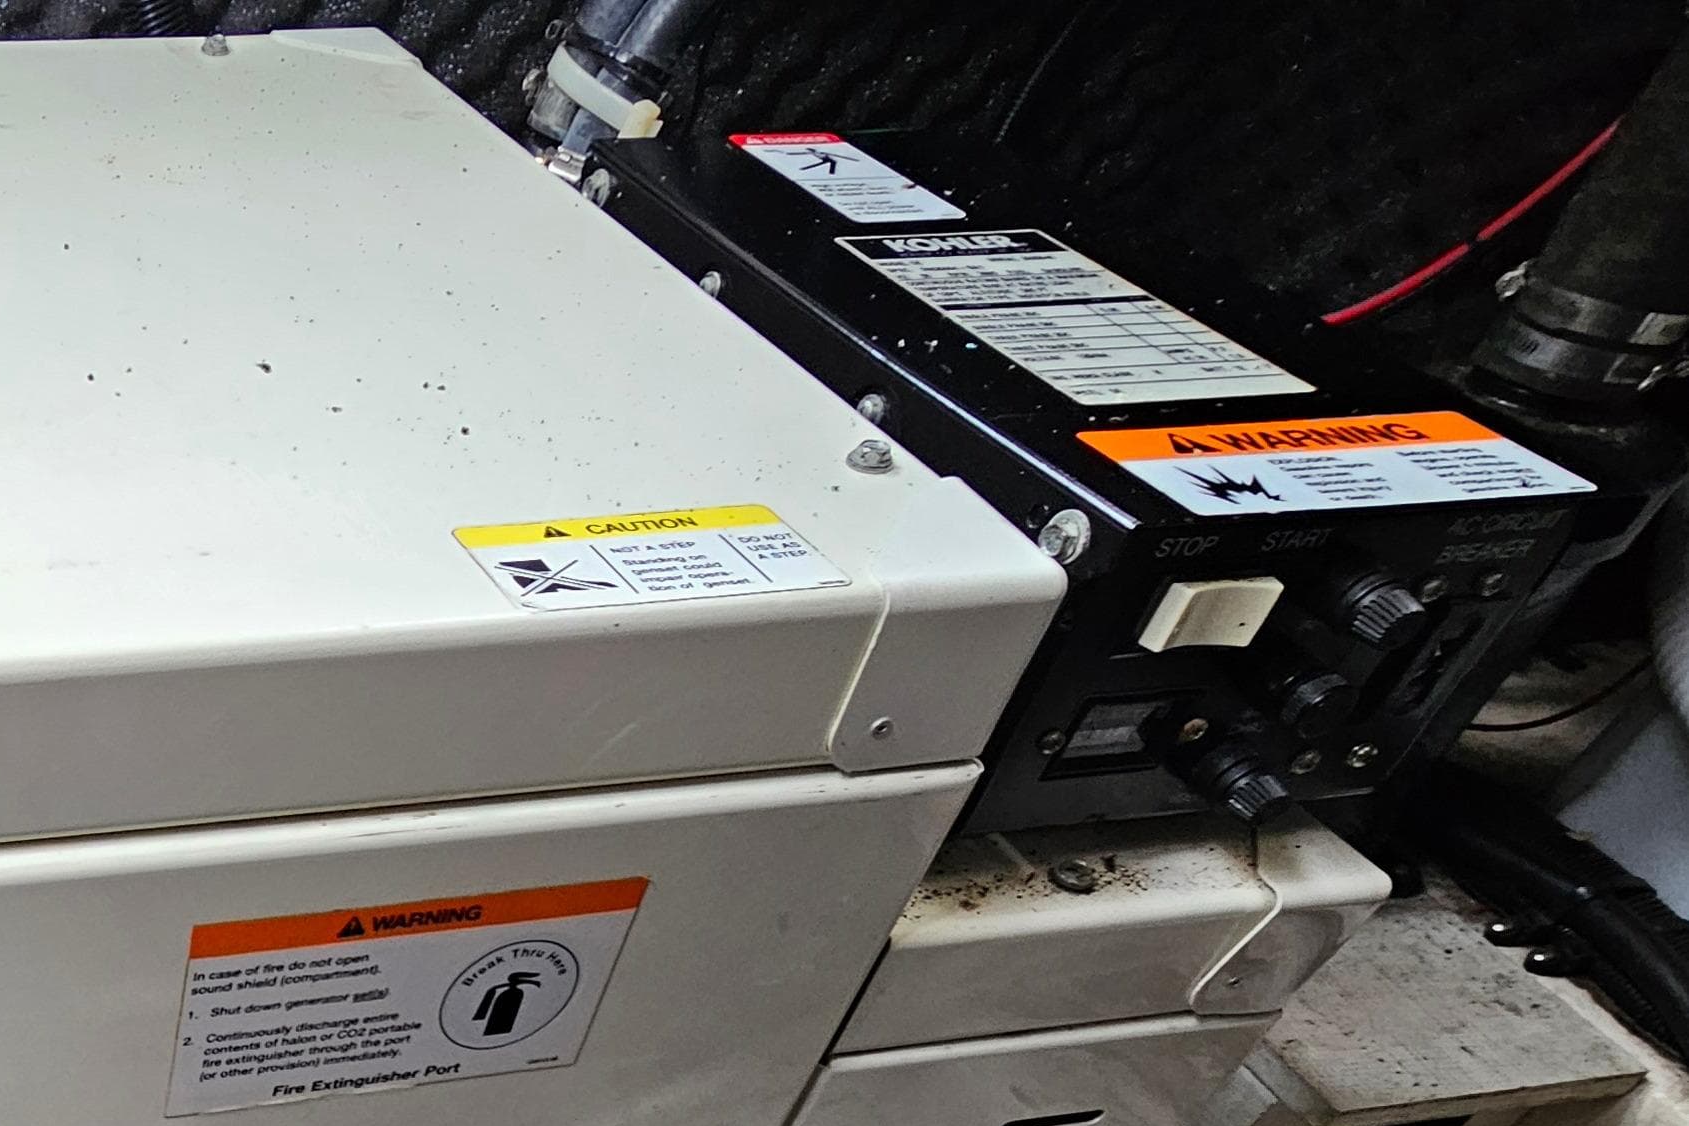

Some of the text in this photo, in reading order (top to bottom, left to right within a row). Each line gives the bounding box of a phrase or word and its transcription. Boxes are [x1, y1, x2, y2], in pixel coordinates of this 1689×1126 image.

[882, 234, 1024, 253] KOHLER
[1213, 424, 1431, 453] WARNING
[586, 516, 699, 535] CAUTION
[763, 532, 793, 541] NOT
[610, 545, 640, 554] NOT
[659, 541, 696, 550] STEP
[747, 541, 801, 552] USE AS
[1155, 536, 1220, 558] STOP
[1262, 528, 1336, 551] START
[622, 555, 687, 566] Standing
[683, 562, 723, 571] could
[371, 904, 483, 933] WARNING
[193, 954, 370, 982] In case of fire do not open
[462, 948, 568, 987] Break Thru Here
[191, 983, 233, 995] sound
[237, 976, 278, 990] shield
[210, 1006, 242, 1018] Shut
[244, 1001, 282, 1013] down
[285, 993, 350, 1011] generator
[203, 1021, 422, 1056] contents of halon or CO2 portable
[206, 1024, 293, 1043] Continuously
[295, 1016, 359, 1033] discharge
[362, 1012, 399, 1023] entire
[202, 1034, 411, 1069] fire extinguisher through the port
[199, 1071, 216, 1083] (or
[220, 1066, 254, 1079] other
[257, 1057, 321, 1076] provision)
[272, 1062, 461, 1097] Fire Extinguisher Port
